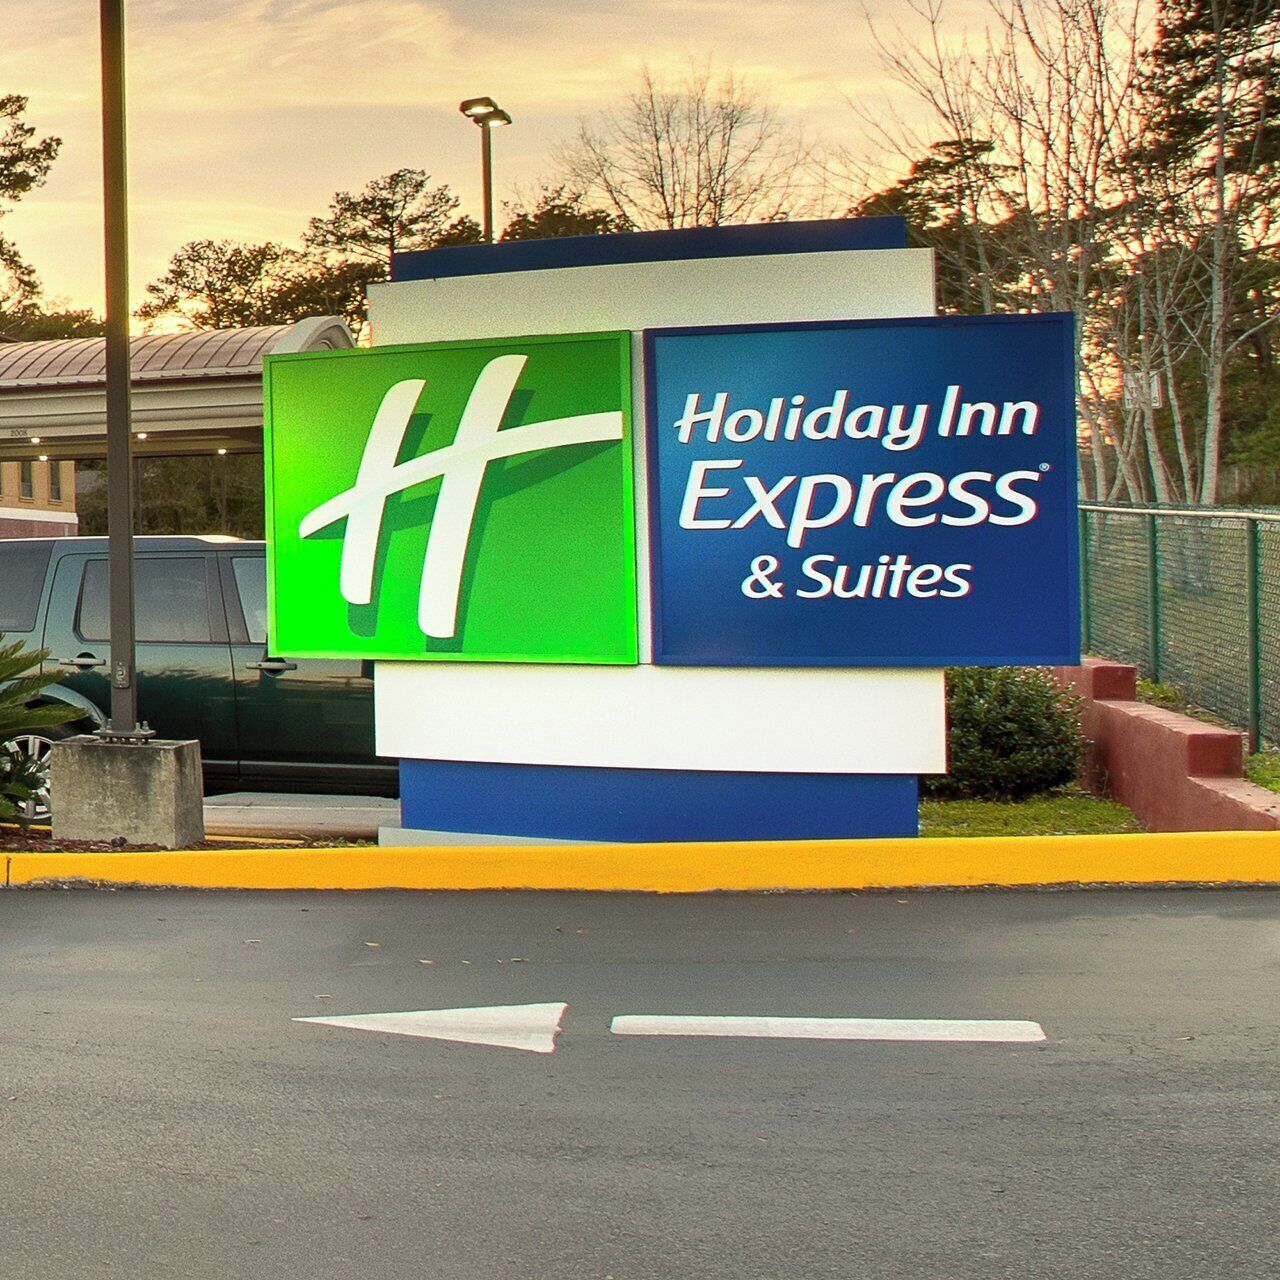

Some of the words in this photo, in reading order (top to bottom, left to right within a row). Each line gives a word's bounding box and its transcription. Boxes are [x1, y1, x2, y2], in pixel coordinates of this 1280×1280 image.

[673, 389, 929, 453] Holiday
[937, 384, 1040, 438] Inn
[678, 459, 1041, 549] Express
[740, 553, 785, 600] &
[795, 553, 975, 600] Suites
